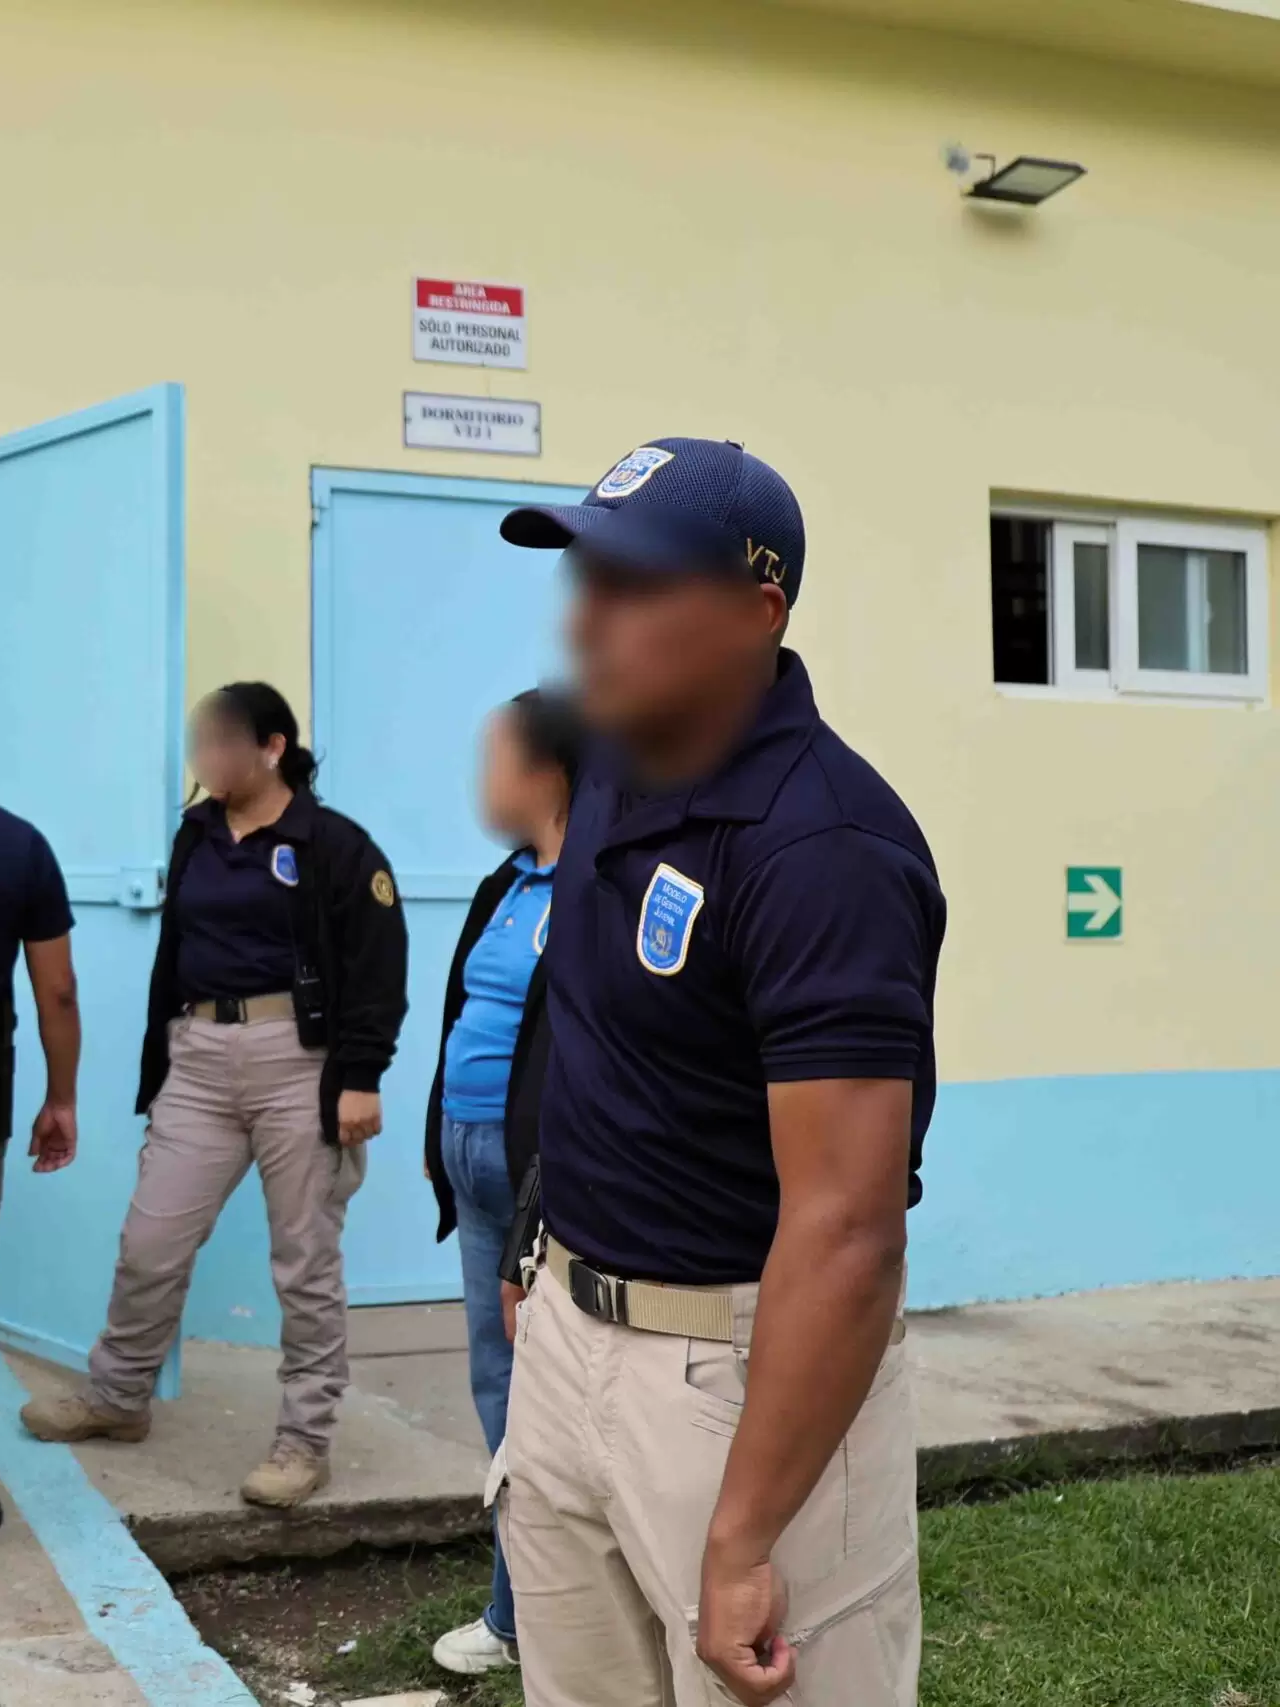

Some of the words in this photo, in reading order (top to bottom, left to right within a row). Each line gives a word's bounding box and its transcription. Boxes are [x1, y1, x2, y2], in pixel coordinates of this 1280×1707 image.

[456, 322, 522, 342] PERSONAL
[431, 337, 511, 357] AUTORIZADO
[421, 405, 524, 427] DORMITORIO
[746, 537, 788, 584] VTJ
